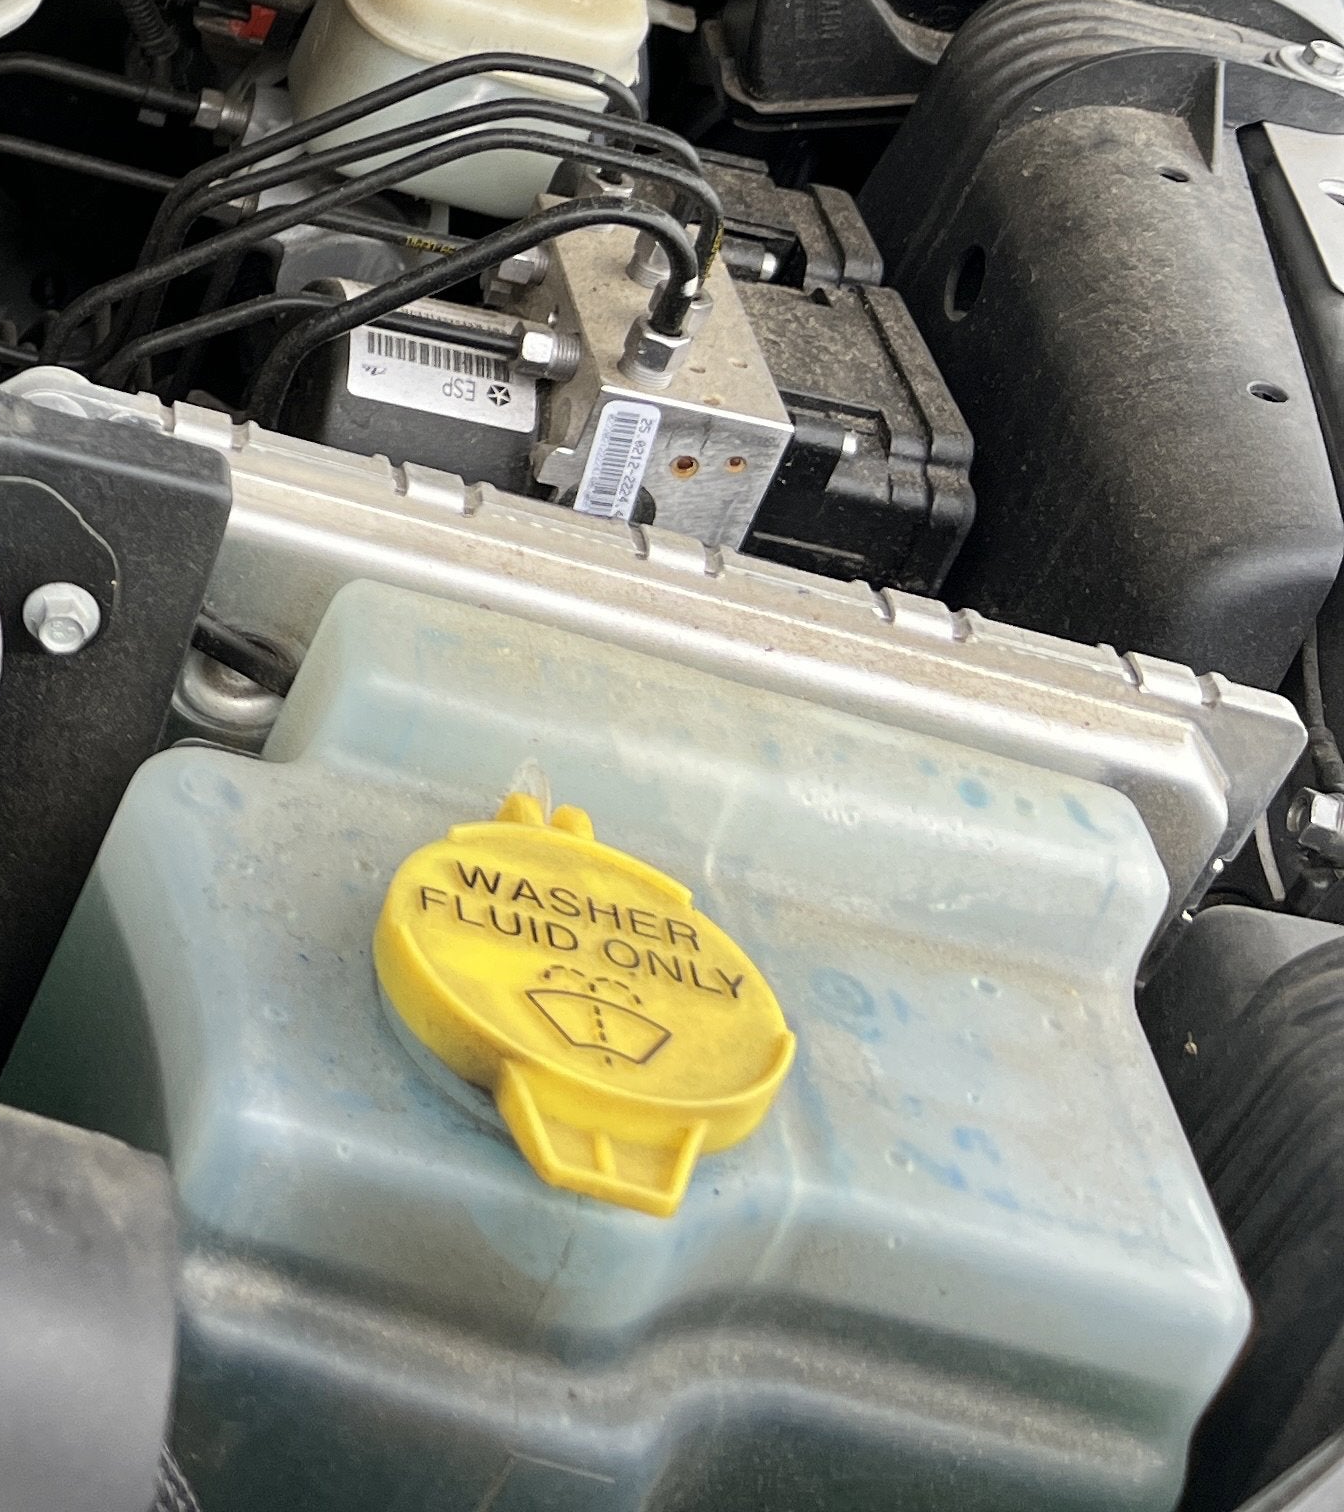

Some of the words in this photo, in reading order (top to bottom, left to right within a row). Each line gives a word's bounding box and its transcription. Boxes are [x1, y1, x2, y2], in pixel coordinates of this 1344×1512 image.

[442, 377, 476, 402] ESP
[419, 885, 580, 953] FLUID
[603, 937, 745, 999] ONLY
[455, 859, 703, 952] WASHER
